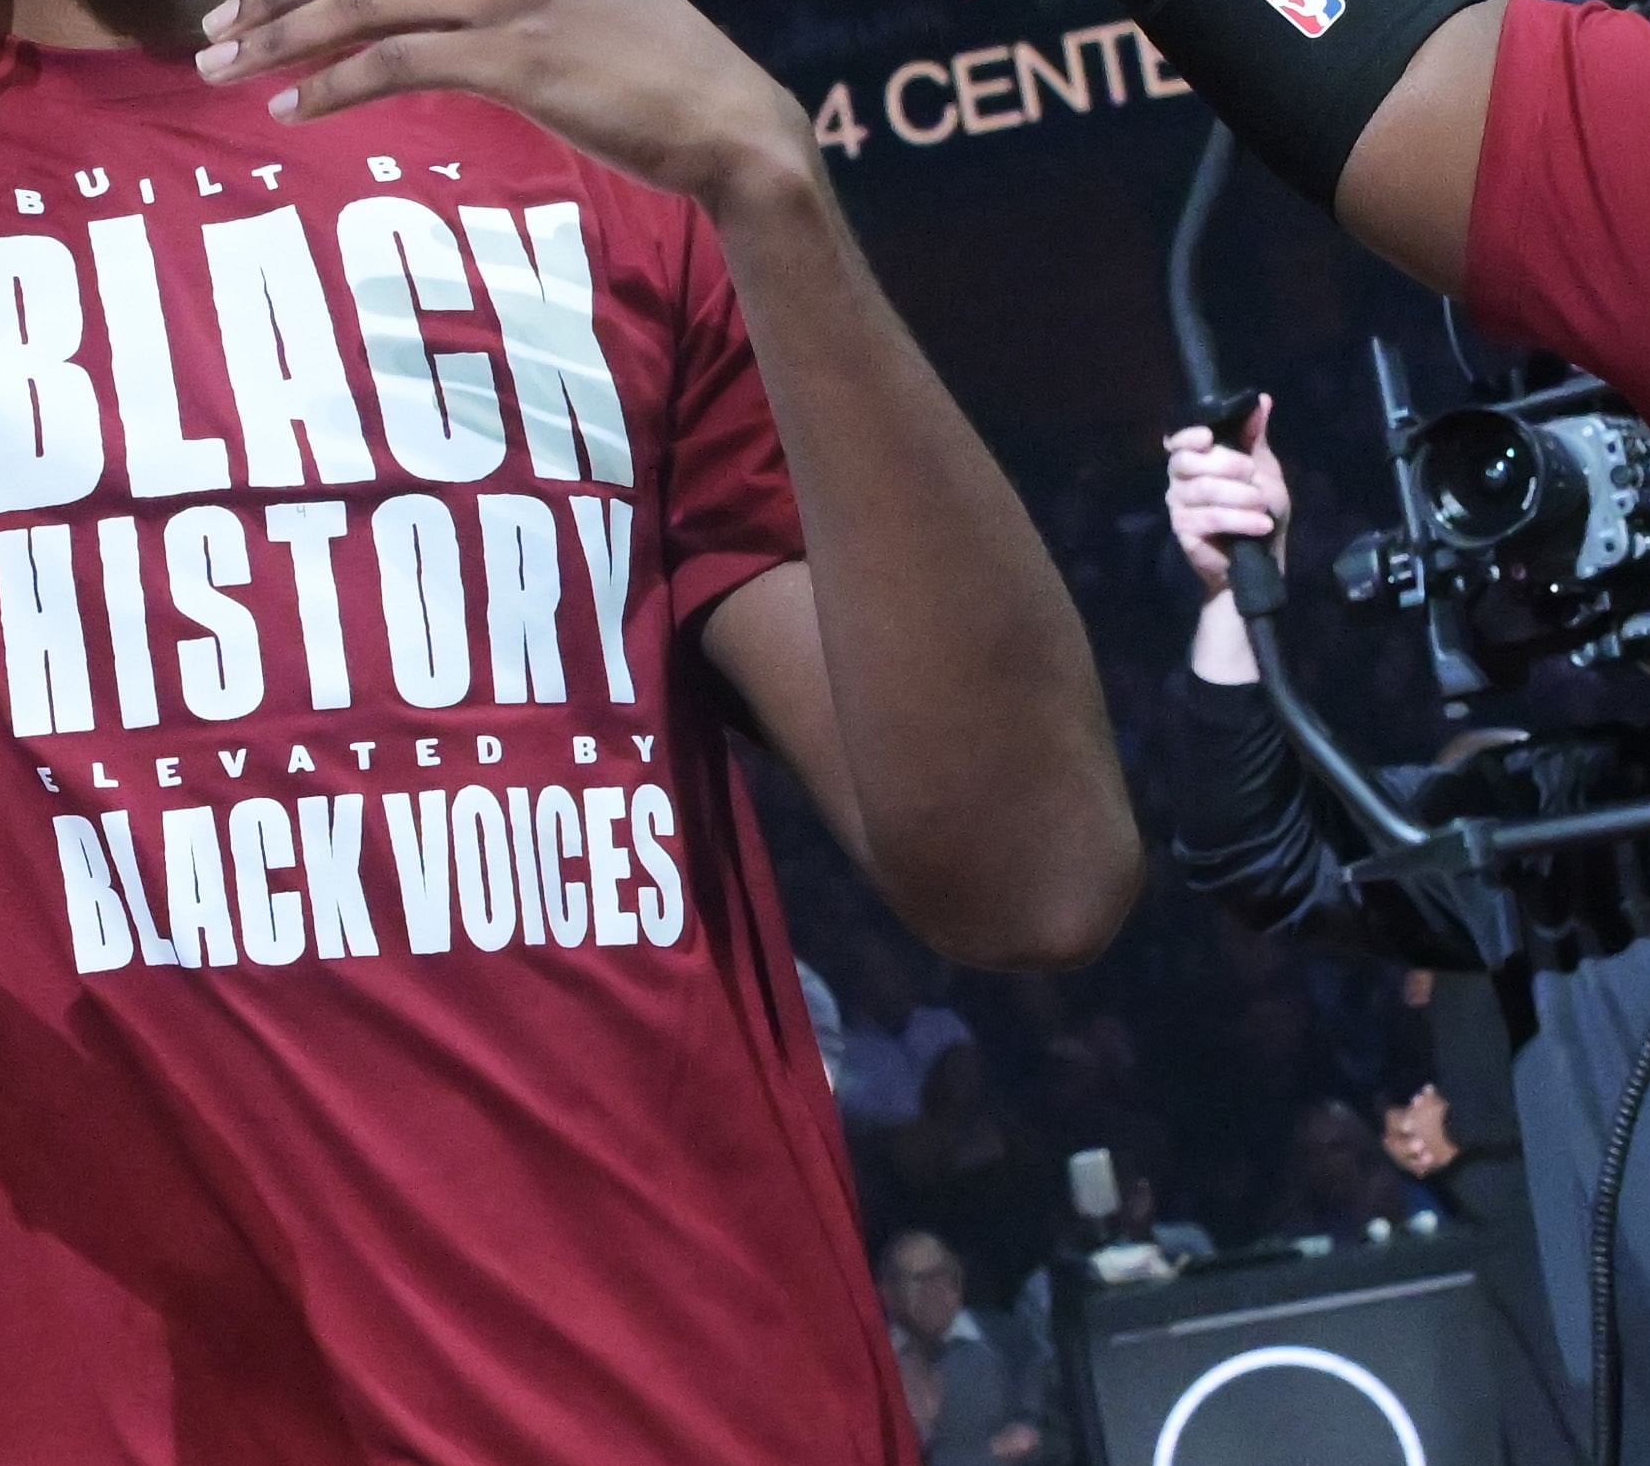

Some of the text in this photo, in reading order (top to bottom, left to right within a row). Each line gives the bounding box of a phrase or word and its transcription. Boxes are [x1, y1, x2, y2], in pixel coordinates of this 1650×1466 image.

[14, 154, 465, 216] BUILT BY
[38, 734, 657, 794] ELEVATED BY
[49, 784, 686, 975] BLACK VOICES
